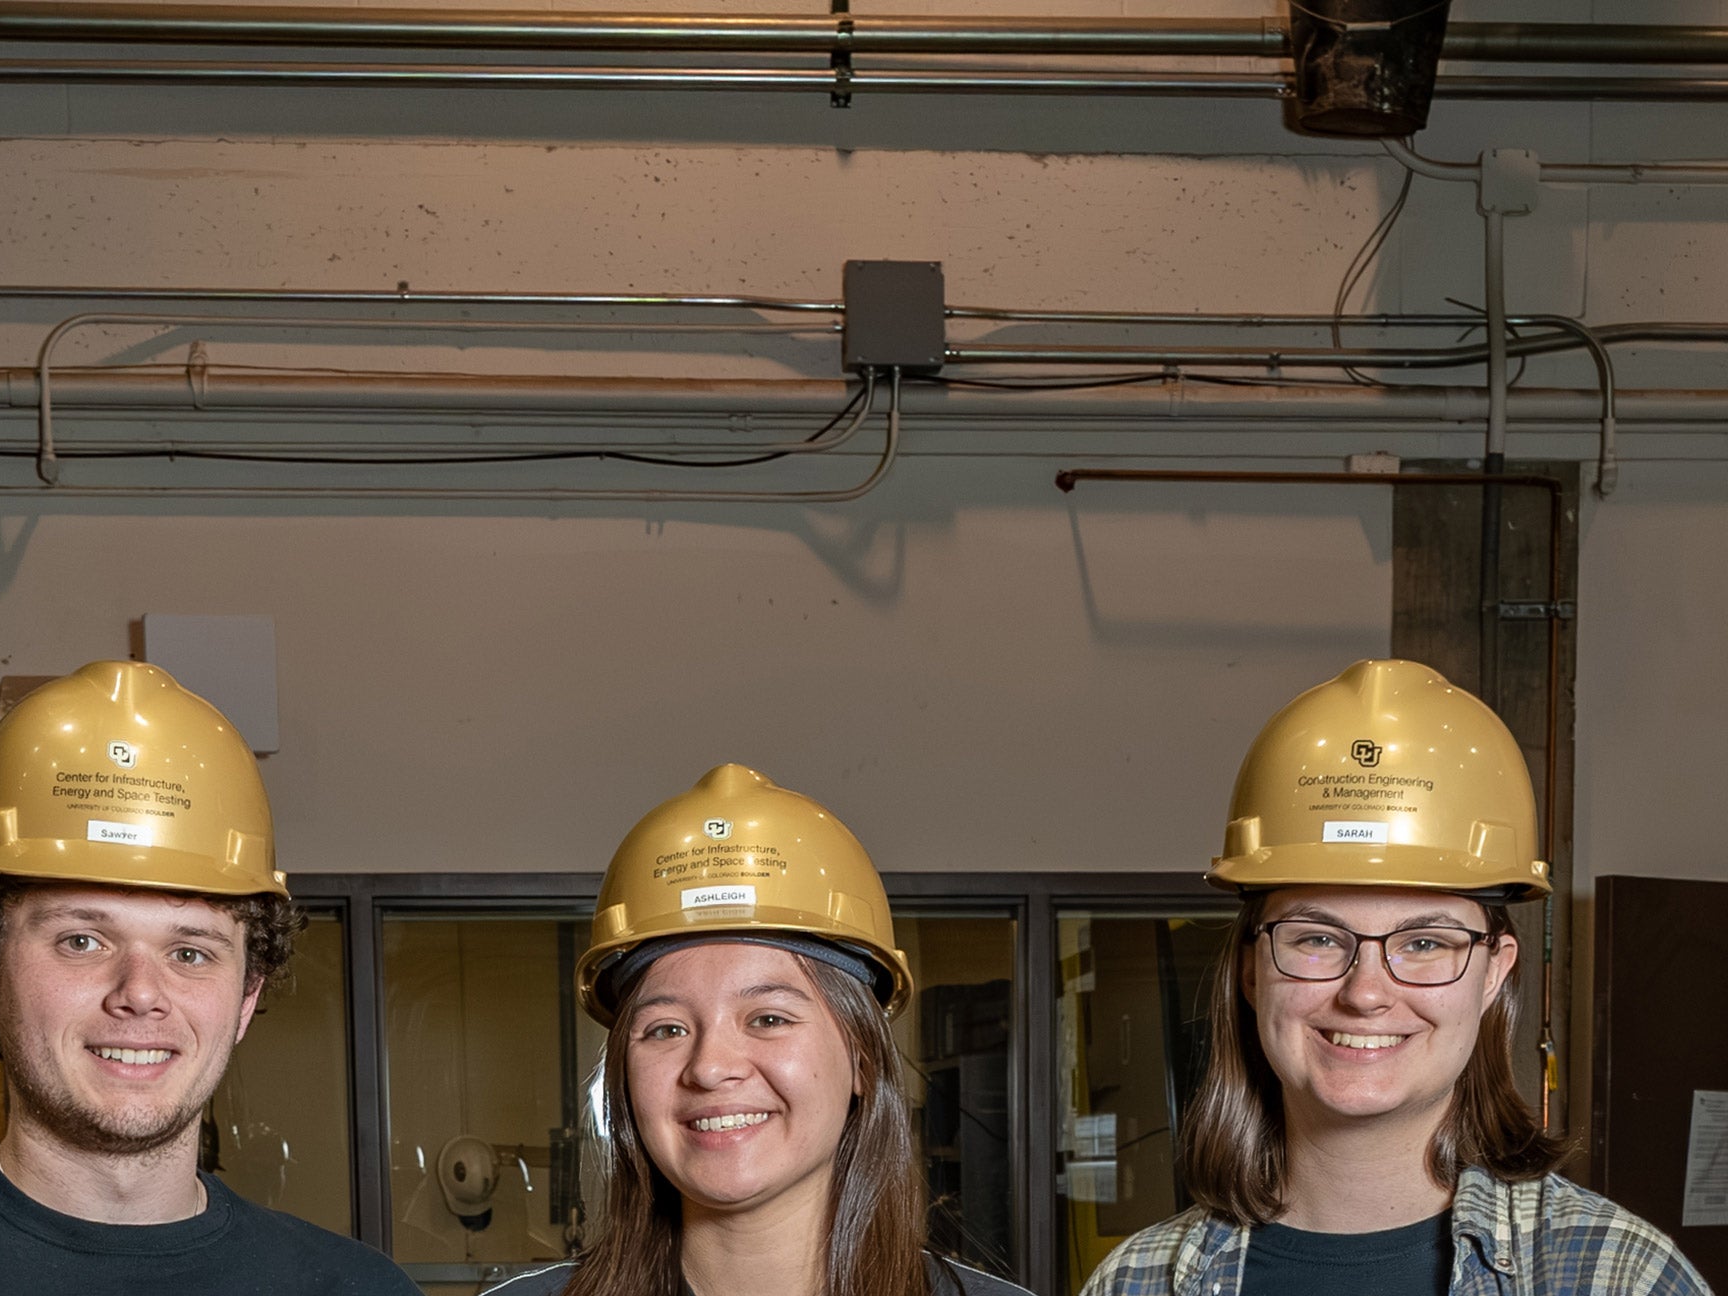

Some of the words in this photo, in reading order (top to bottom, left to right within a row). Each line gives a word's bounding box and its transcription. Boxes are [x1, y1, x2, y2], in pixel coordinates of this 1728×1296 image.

[56, 771, 92, 783] Center
[95, 771, 109, 783] for
[112, 774, 186, 794] Infrastructure,
[1298, 773, 1365, 787] Construction
[1368, 773, 1434, 791] Engineering
[52, 786, 91, 799] Energy
[93, 787, 114, 799] and
[117, 789, 151, 802] Space
[154, 792, 191, 810] Testing
[1322, 788, 1330, 799] &
[1333, 787, 1404, 800] Management
[100, 828, 138, 841] Sawyer
[1337, 828, 1373, 839] SARAH
[656, 850, 689, 866] Center
[691, 846, 706, 856] for
[707, 843, 781, 857] Infrastructure,
[653, 864, 688, 879] Energy
[690, 859, 710, 870] and
[712, 856, 744, 867] Space
[694, 892, 746, 904] ASHLEIGH
